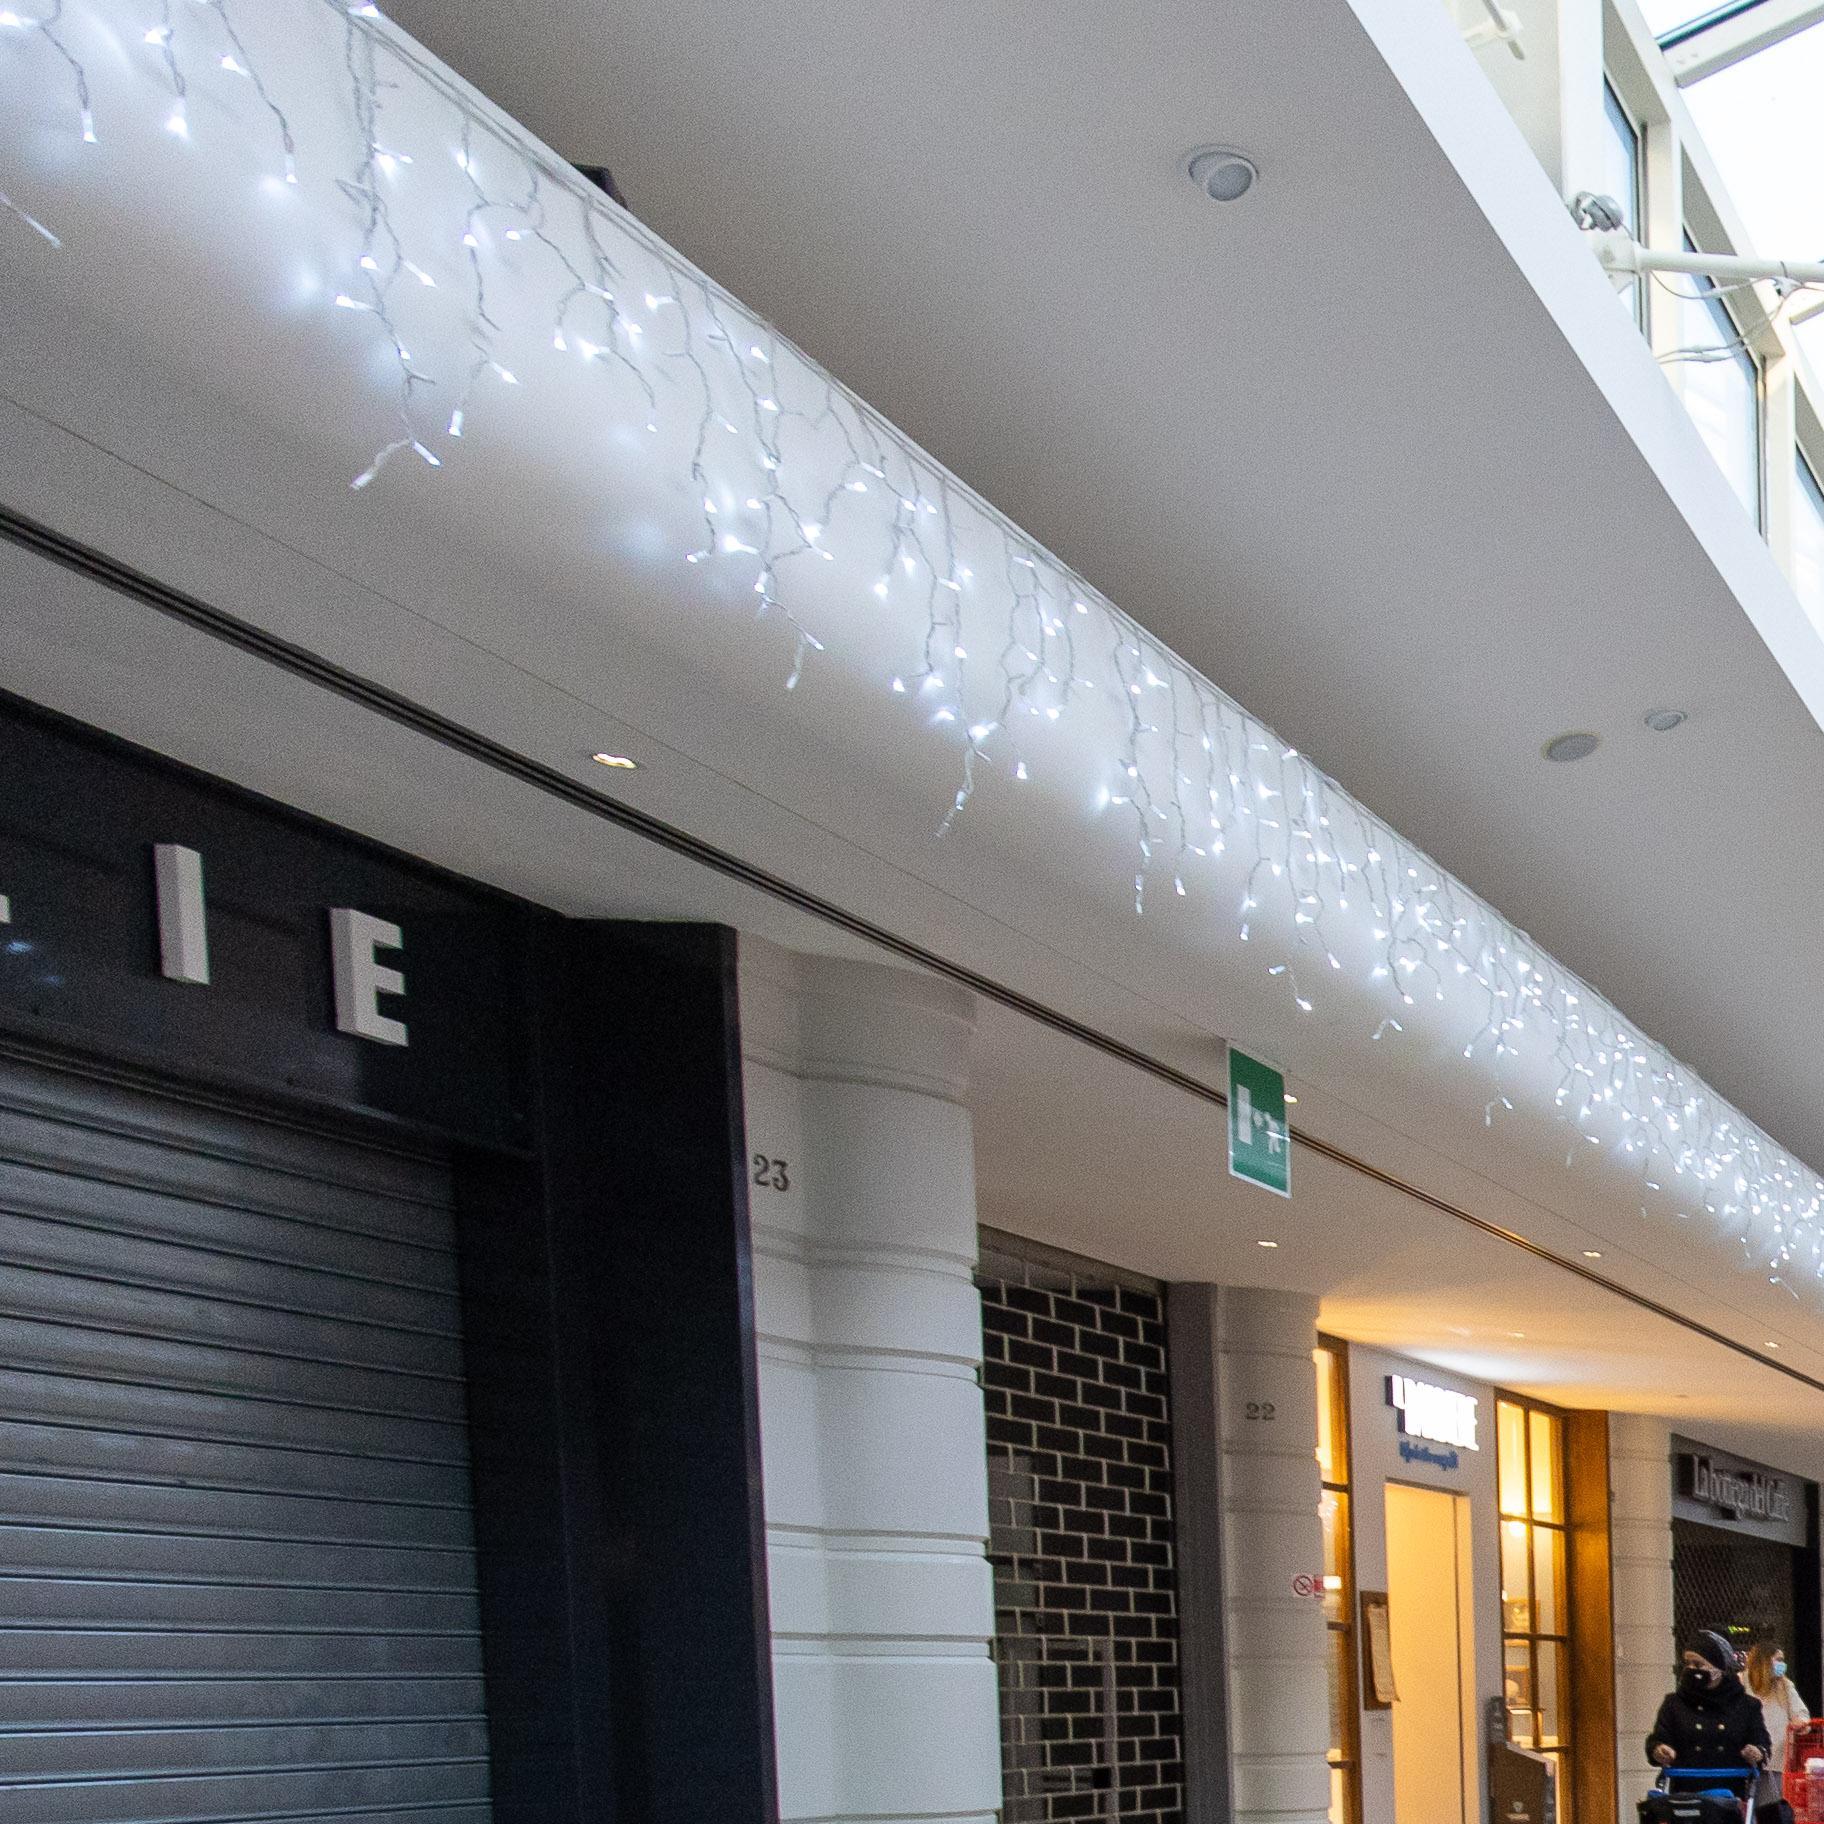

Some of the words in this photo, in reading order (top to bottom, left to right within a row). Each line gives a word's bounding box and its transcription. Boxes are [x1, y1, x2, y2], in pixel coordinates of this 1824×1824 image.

[0, 842, 409, 1047] IE
[752, 1153, 790, 1192] 23
[1245, 1402, 1276, 1421] 22
